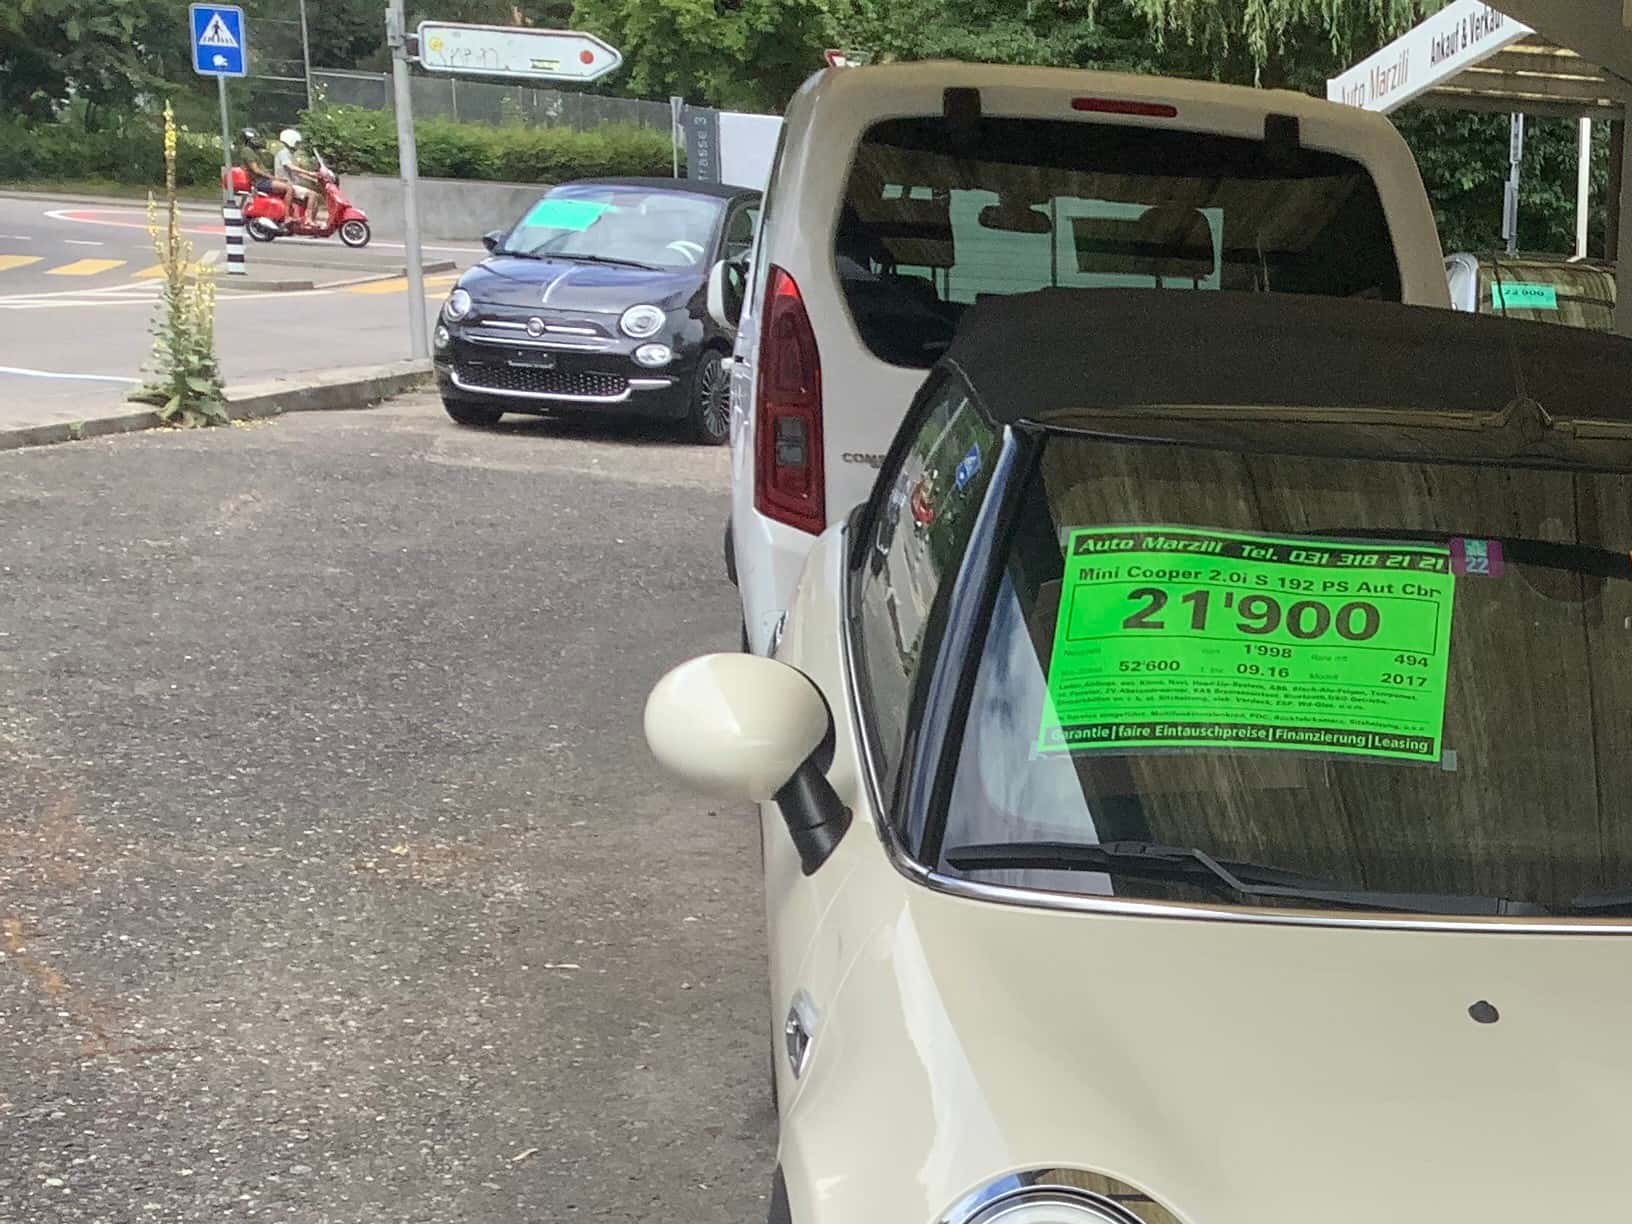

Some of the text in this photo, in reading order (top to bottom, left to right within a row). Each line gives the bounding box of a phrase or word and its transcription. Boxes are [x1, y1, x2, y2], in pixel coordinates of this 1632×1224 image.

[1430, 22, 1459, 68] Ankauf
[1461, 18, 1467, 49] &
[1079, 538, 1134, 552] Auto
[1242, 545, 1279, 561] Tel.
[1289, 550, 1330, 565] 031
[1337, 553, 1377, 567] 318
[1385, 555, 1411, 568] 21
[1418, 556, 1445, 570] 21
[1079, 567, 1120, 581] Mini
[1127, 566, 1203, 581] Cooper
[1208, 569, 1248, 584] 2.0i
[1255, 574, 1269, 586] S
[1278, 577, 1314, 591] 192
[1322, 581, 1349, 593] PS
[1356, 582, 1394, 595] Aut
[1122, 587, 1381, 641] 21'900
[1244, 644, 1429, 668] 1'998 494
[1118, 660, 1181, 672] 52'600
[1236, 663, 1290, 678] 09.16
[1380, 672, 1428, 688] 2017
[1051, 725, 1429, 752] Garantie faire Eintauschpreise Finanzierung Leasing
